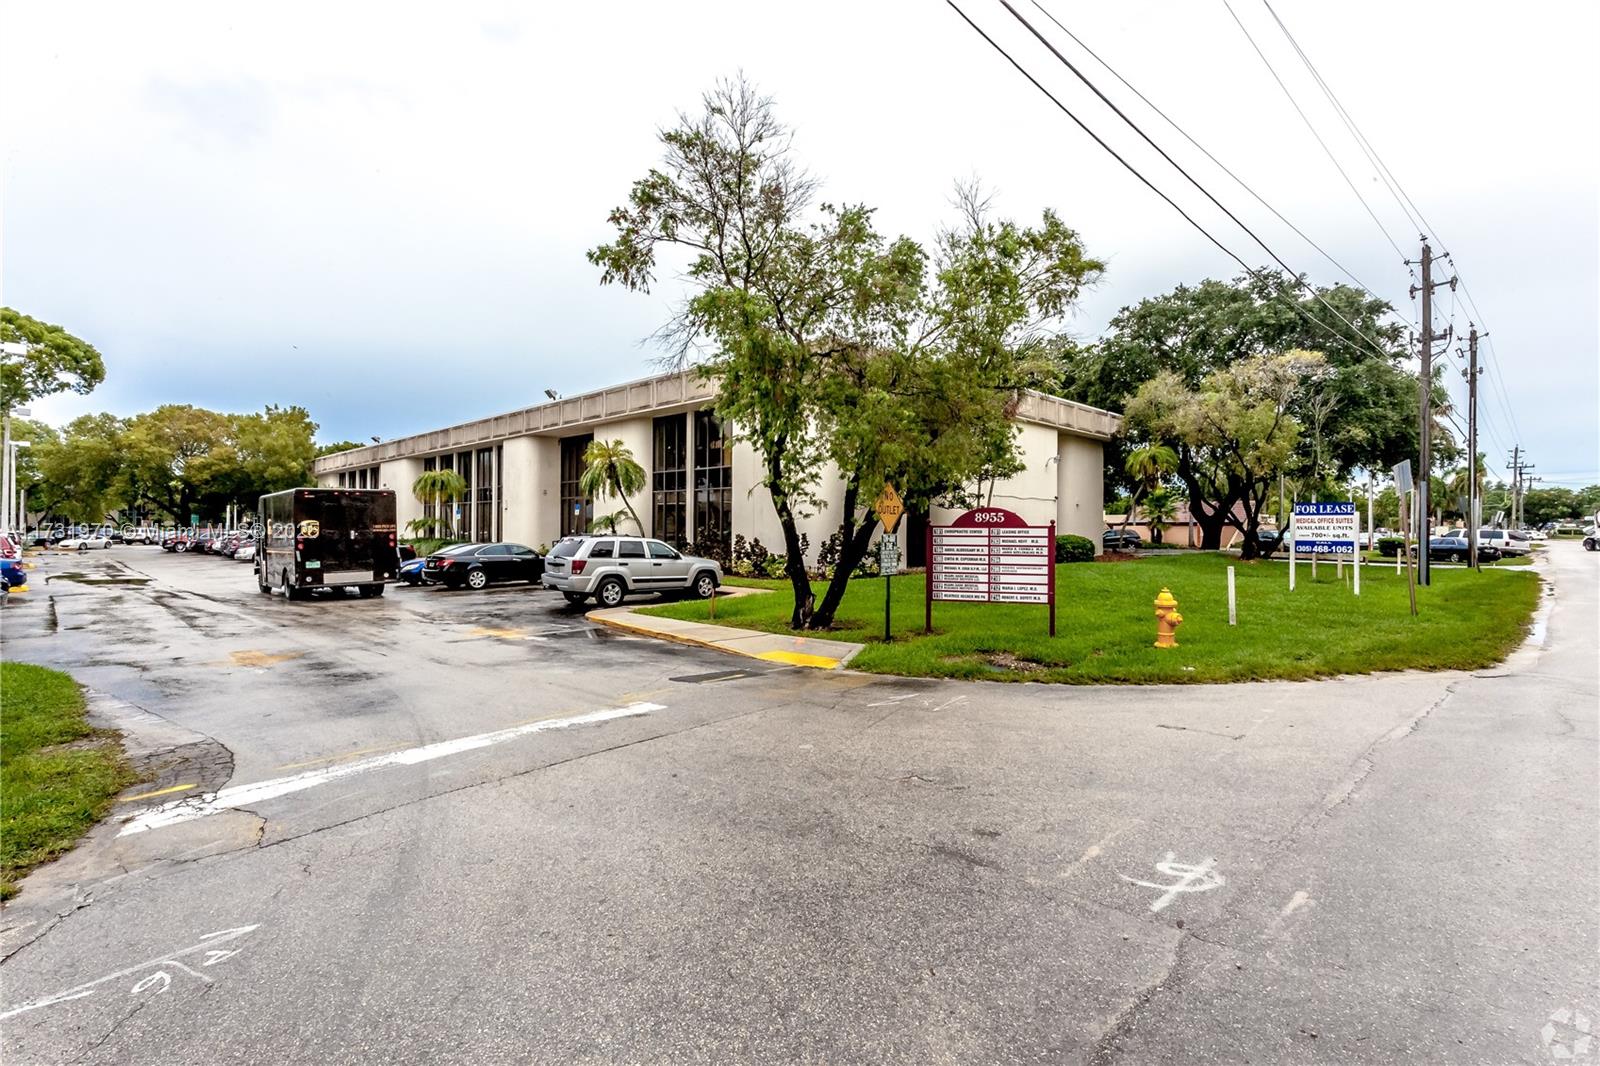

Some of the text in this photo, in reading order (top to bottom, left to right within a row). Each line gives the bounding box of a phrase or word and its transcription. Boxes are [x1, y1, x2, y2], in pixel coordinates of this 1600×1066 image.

[884, 492, 894, 500] NO
[878, 505, 900, 514] OUTLET
[1296, 504, 1354, 514] FOR LEASE
[974, 512, 1004, 522] 8955
